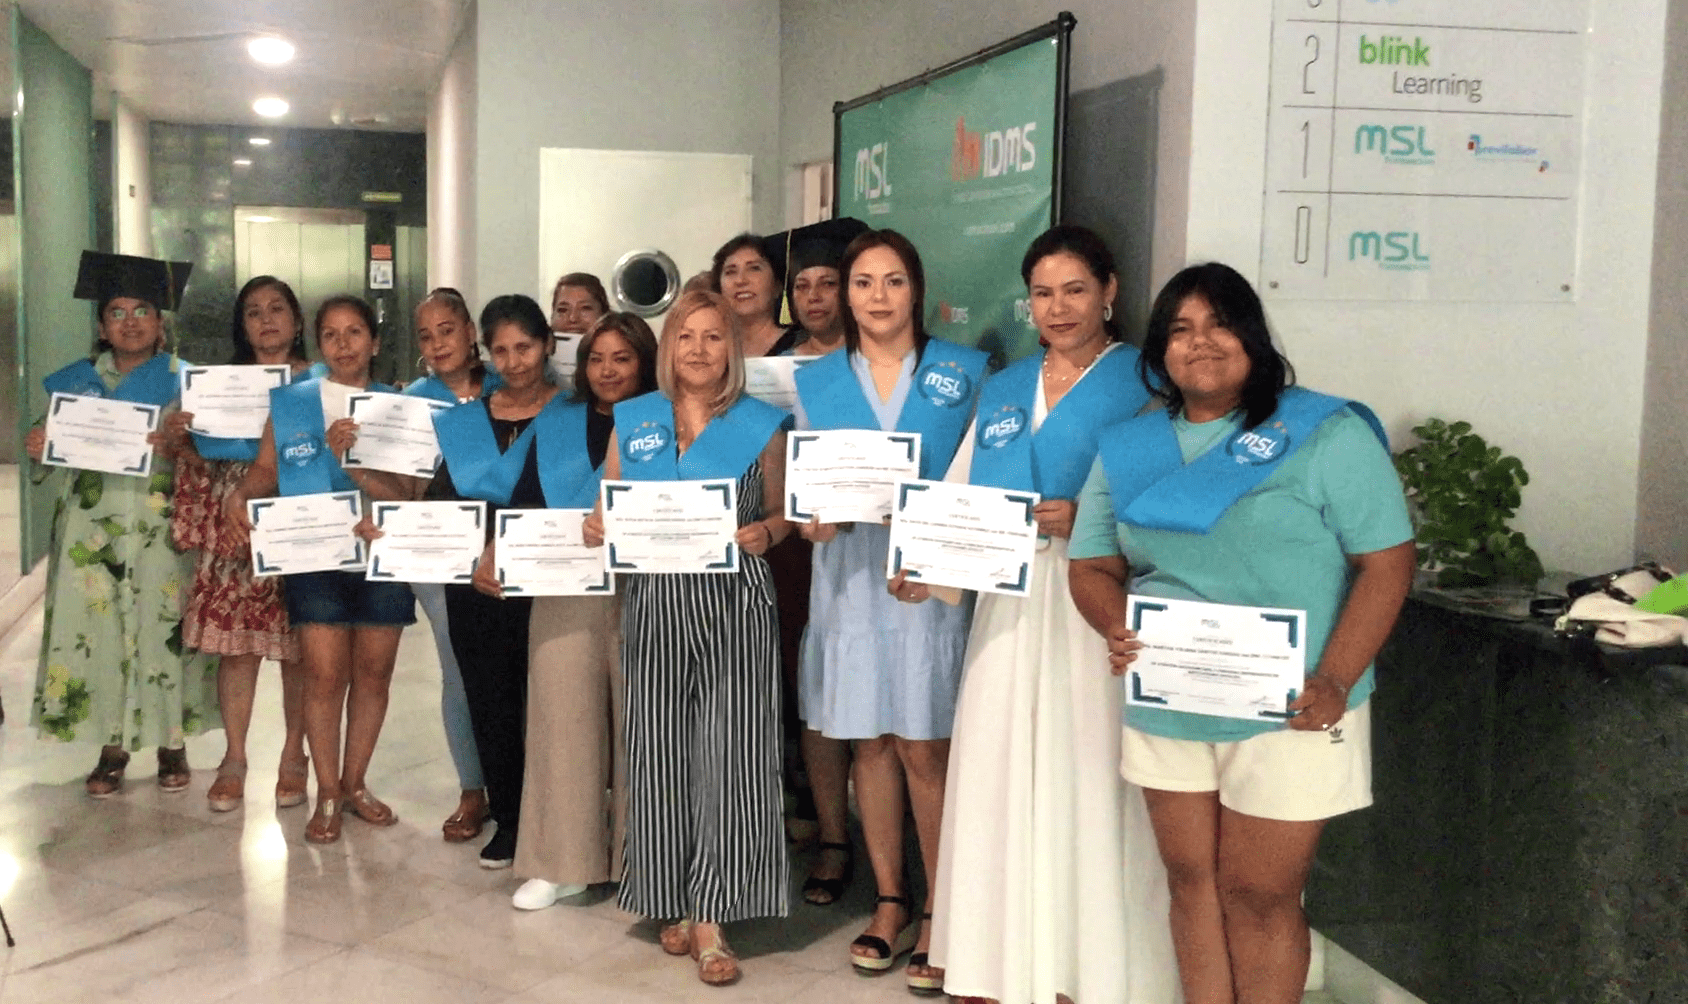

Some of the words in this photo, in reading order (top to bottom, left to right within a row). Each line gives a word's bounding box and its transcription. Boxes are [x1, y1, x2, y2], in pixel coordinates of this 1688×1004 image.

[1302, 34, 1320, 94] 2
[1358, 35, 1431, 66] blink
[1392, 71, 1483, 103] Learning
[1301, 120, 1309, 179] 1
